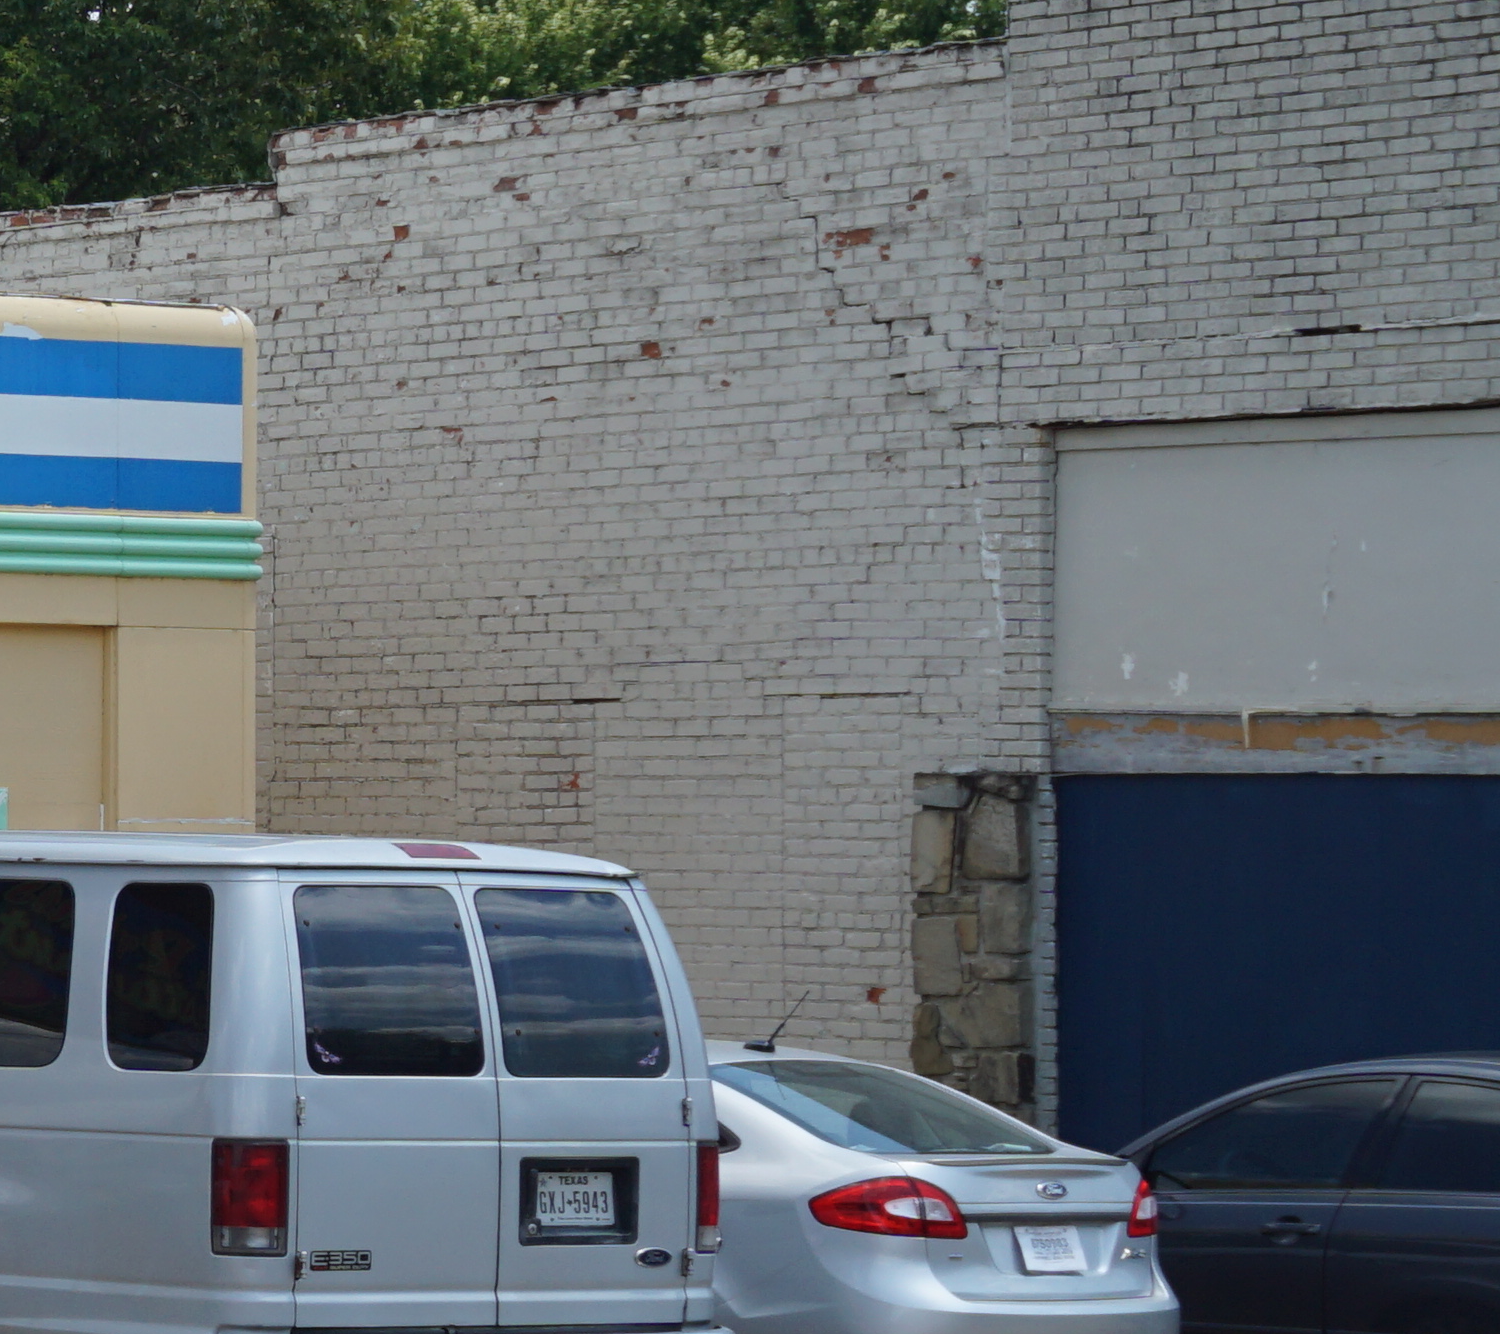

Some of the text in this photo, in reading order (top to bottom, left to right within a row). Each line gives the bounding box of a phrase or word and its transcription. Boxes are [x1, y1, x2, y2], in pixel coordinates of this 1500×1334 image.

[558, 1176, 589, 1185] TEXAS
[539, 1191, 609, 1214] GXJ 5943
